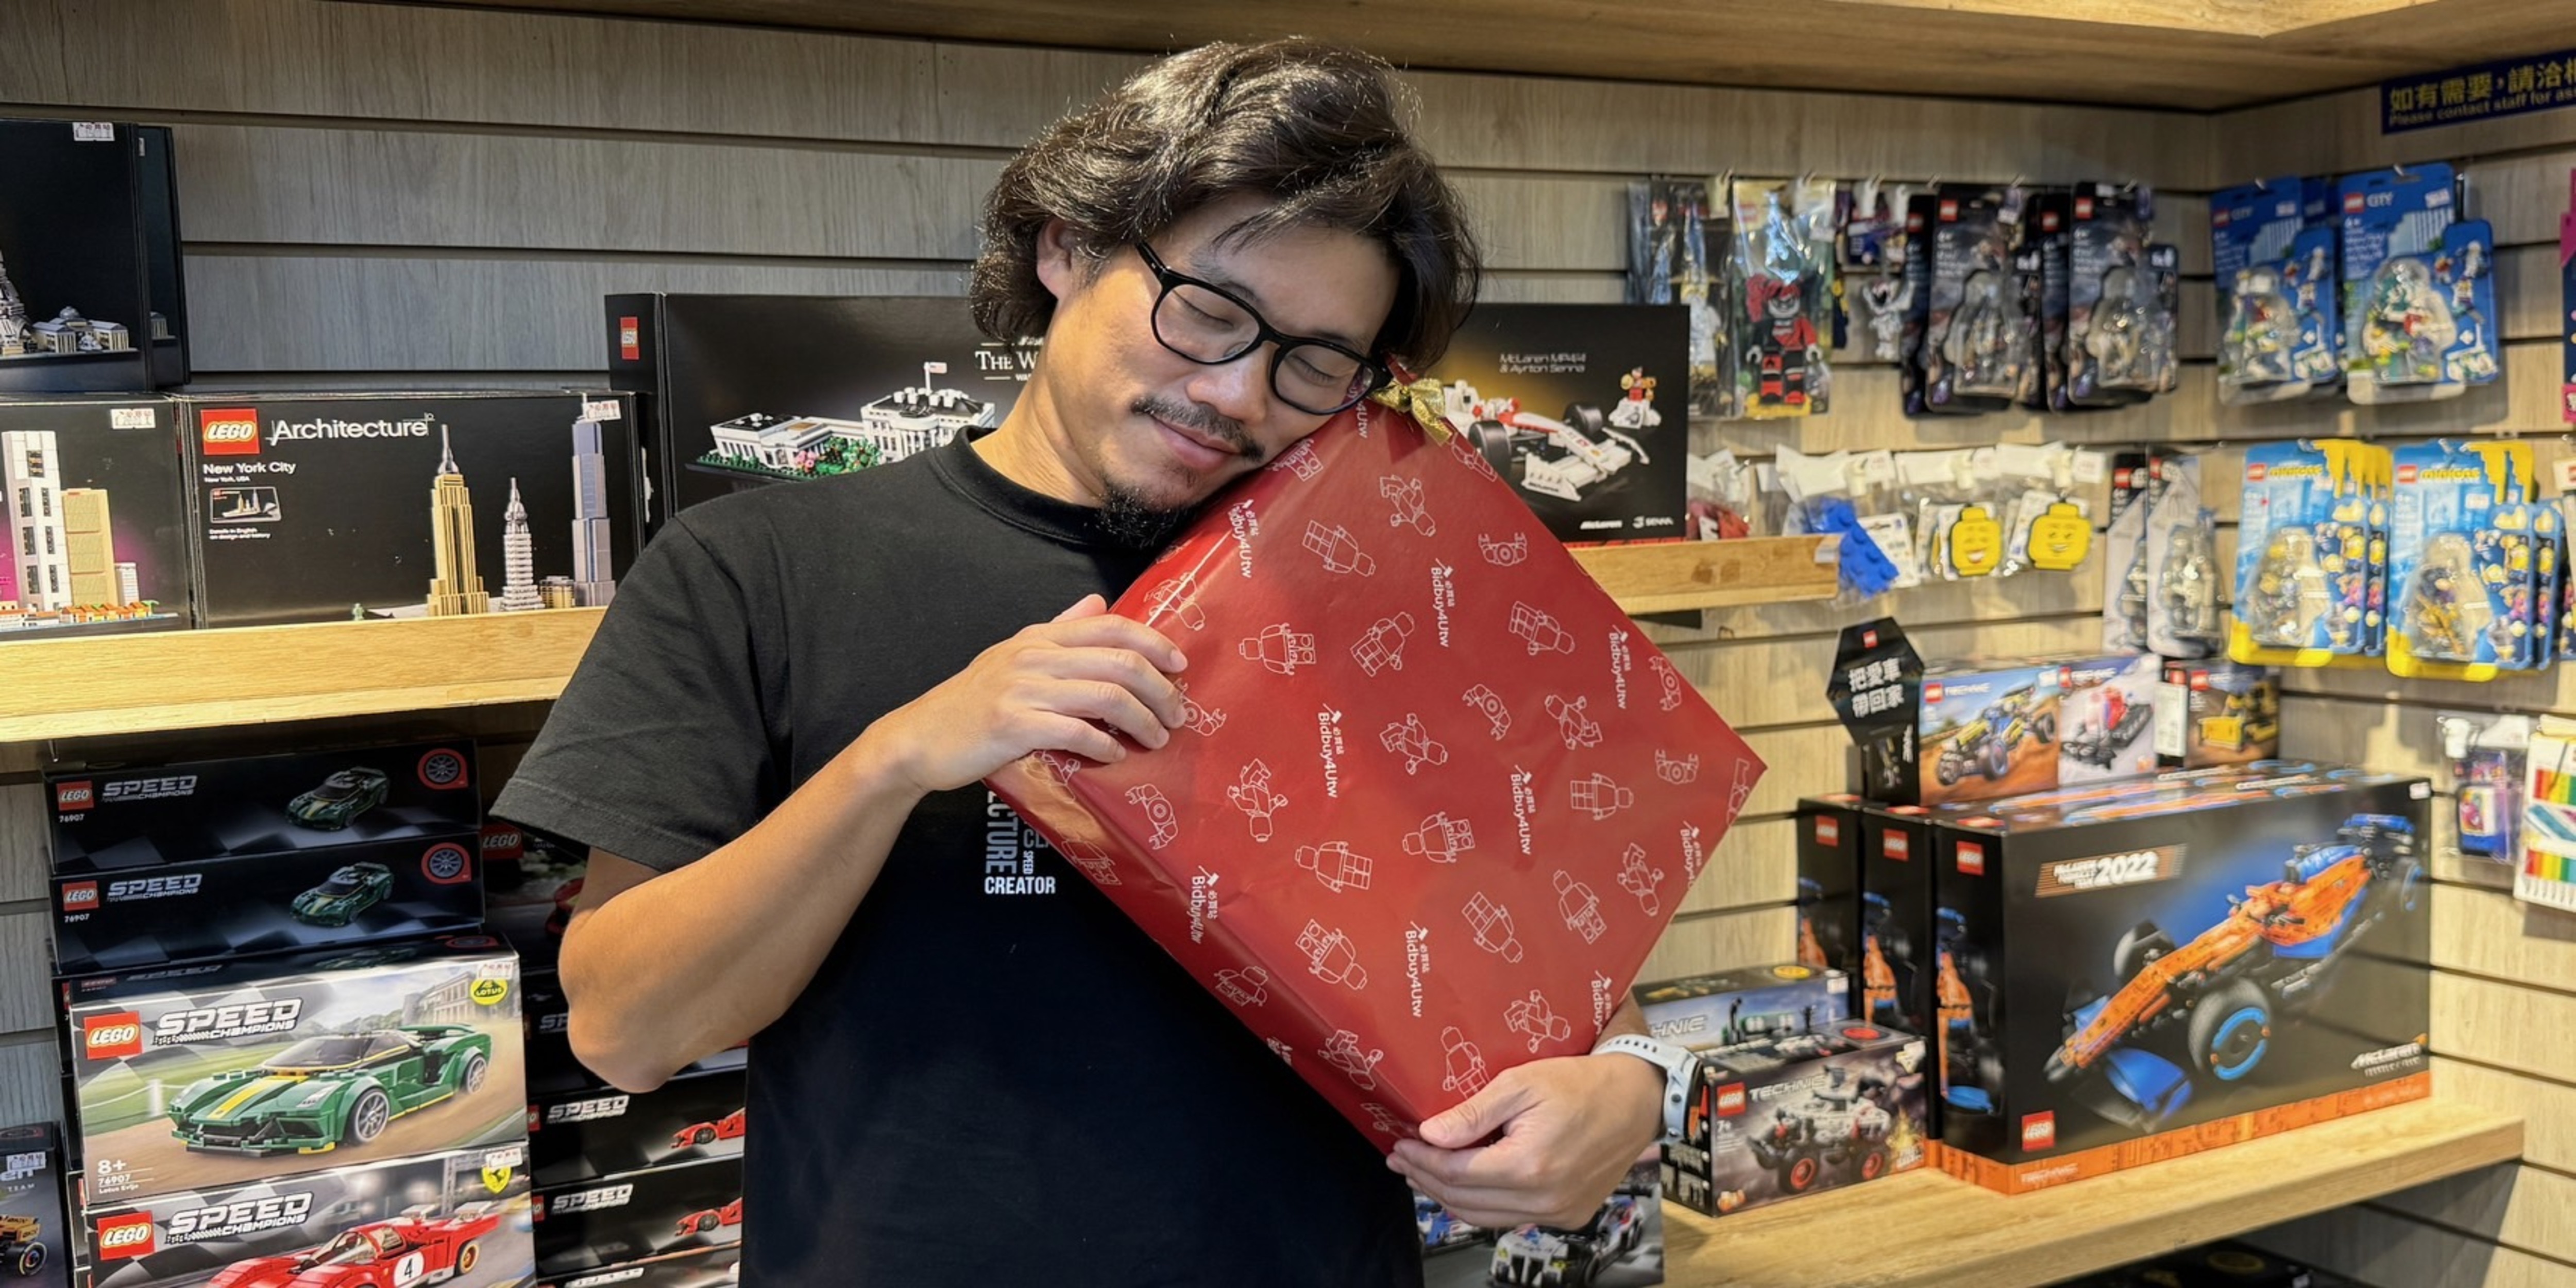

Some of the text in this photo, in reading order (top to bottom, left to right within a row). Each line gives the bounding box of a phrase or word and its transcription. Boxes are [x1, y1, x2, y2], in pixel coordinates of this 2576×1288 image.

[2389, 112, 2433, 127] Please
[2437, 102, 2490, 118] contact
[2495, 94, 2526, 111] staff
[2531, 90, 2551, 105] for
[975, 351, 1013, 370] THE
[1510, 364, 1548, 375] Ayrton
[1550, 364, 1585, 373] Senna
[205, 421, 256, 442] LEGO
[268, 418, 429, 446] Architecture
[203, 461, 296, 474] New York City
[1431, 567, 1449, 647] Bidbuy4Utw
[1609, 633, 1626, 709] Bidbuy4Utw
[1849, 658, 1901, 692] 把愛車
[1852, 685, 1904, 717] 帶回家
[1318, 713, 1338, 798] Bidbuy4Utw
[60, 775, 197, 802] LEGO SPEED
[138, 788, 194, 800] CHAMPIONS
[59, 814, 84, 823] 76907
[1511, 774, 1531, 855] Bidbuy4Utw
[484, 833, 519, 849] LEGO
[986, 791, 1019, 874] CTURE
[1022, 851, 1034, 874] SPEED
[2094, 851, 2159, 887] 2022
[64, 874, 202, 902] LEGO SPEED
[142, 887, 199, 901] CHAMPIONS
[985, 876, 1056, 894] CREATOR
[64, 914, 90, 923] 76907
[1405, 930, 1422, 1018] Bidbuy4Utw
[476, 987, 503, 996] LOTUS
[88, 999, 302, 1048] LEGO SPEED
[209, 1021, 295, 1040] CHAMPIONS
[1650, 1014, 1707, 1038] HNIC
[1749, 1074, 1826, 1102] TECHNIC
[549, 1095, 630, 1120] SPEED
[98, 1159, 127, 1175] 8+
[8, 1183, 35, 1193] TEAM
[98, 1174, 131, 1187] 76907
[553, 1184, 633, 1211] SPEED
[100, 1192, 313, 1247] LEGO SPEED
[221, 1214, 306, 1235] CHAMPIONS
[404, 1259, 413, 1278] 4
